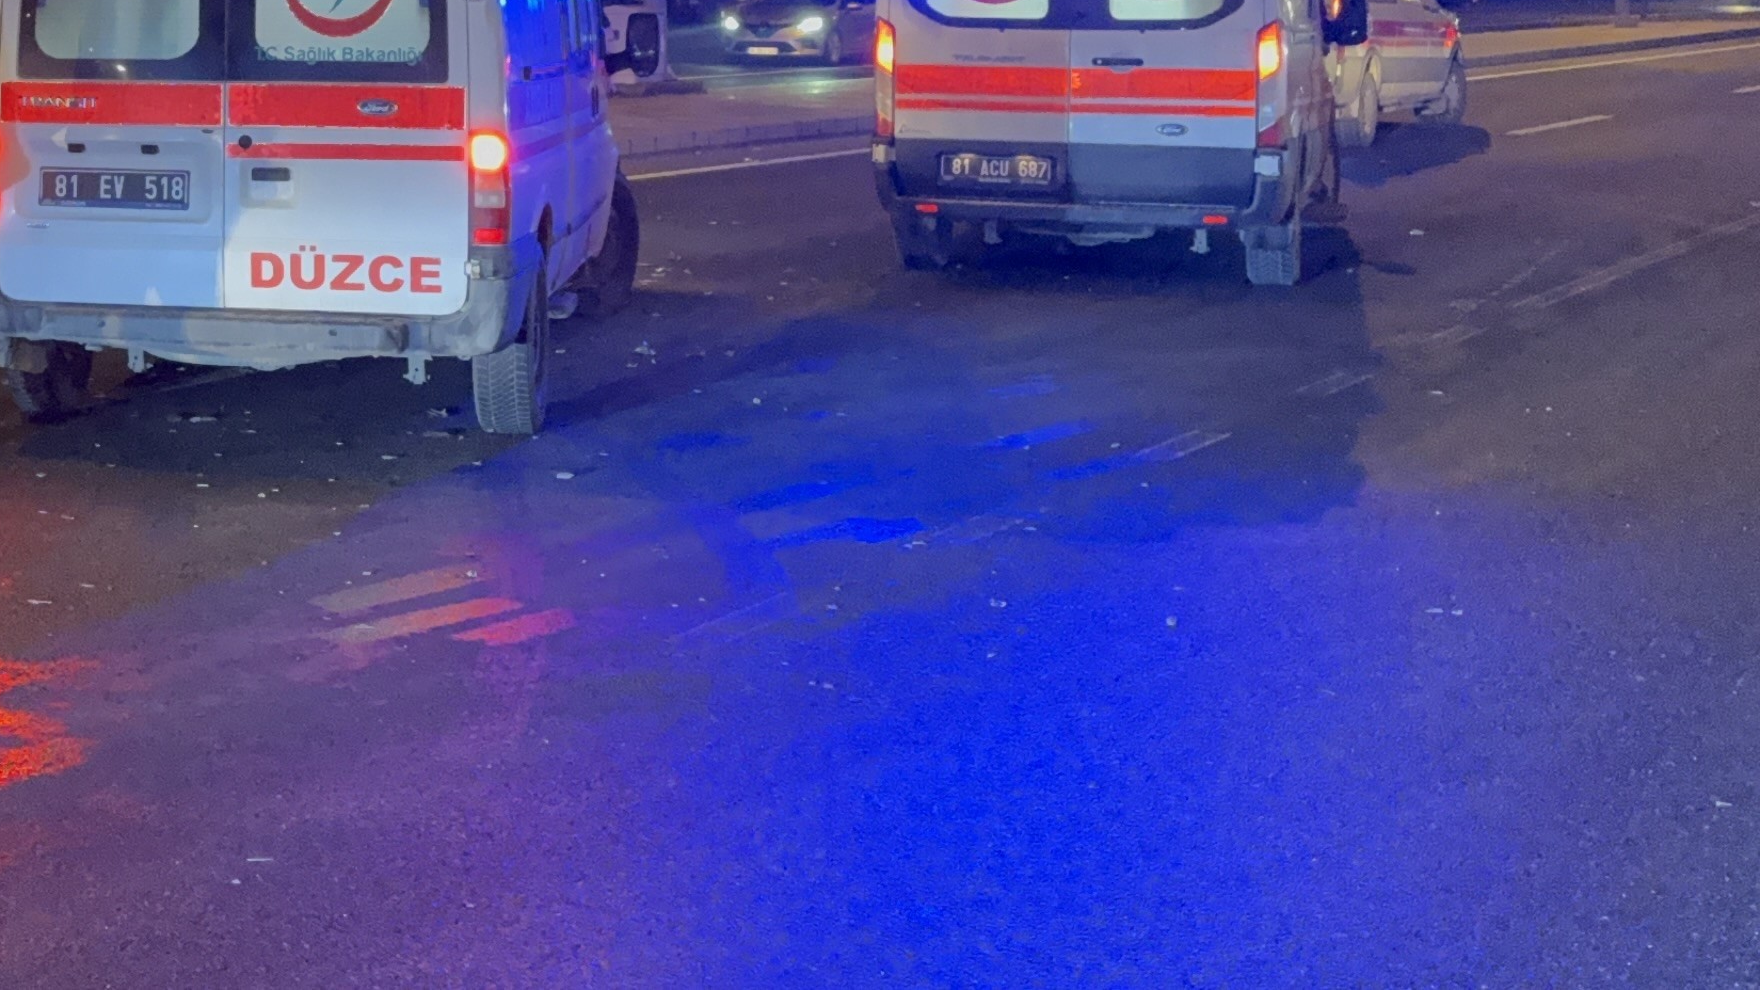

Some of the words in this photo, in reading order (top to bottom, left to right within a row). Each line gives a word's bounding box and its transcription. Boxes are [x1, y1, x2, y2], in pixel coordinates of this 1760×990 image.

[284, 46, 337, 66] Sağlık
[341, 46, 424, 67] Bakanlığı
[952, 158, 970, 175] 81
[1018, 160, 1048, 178] 687
[55, 174, 78, 198] 81
[99, 174, 125, 200] EV
[144, 175, 184, 201] 518
[250, 244, 443, 294] DÜZCE
